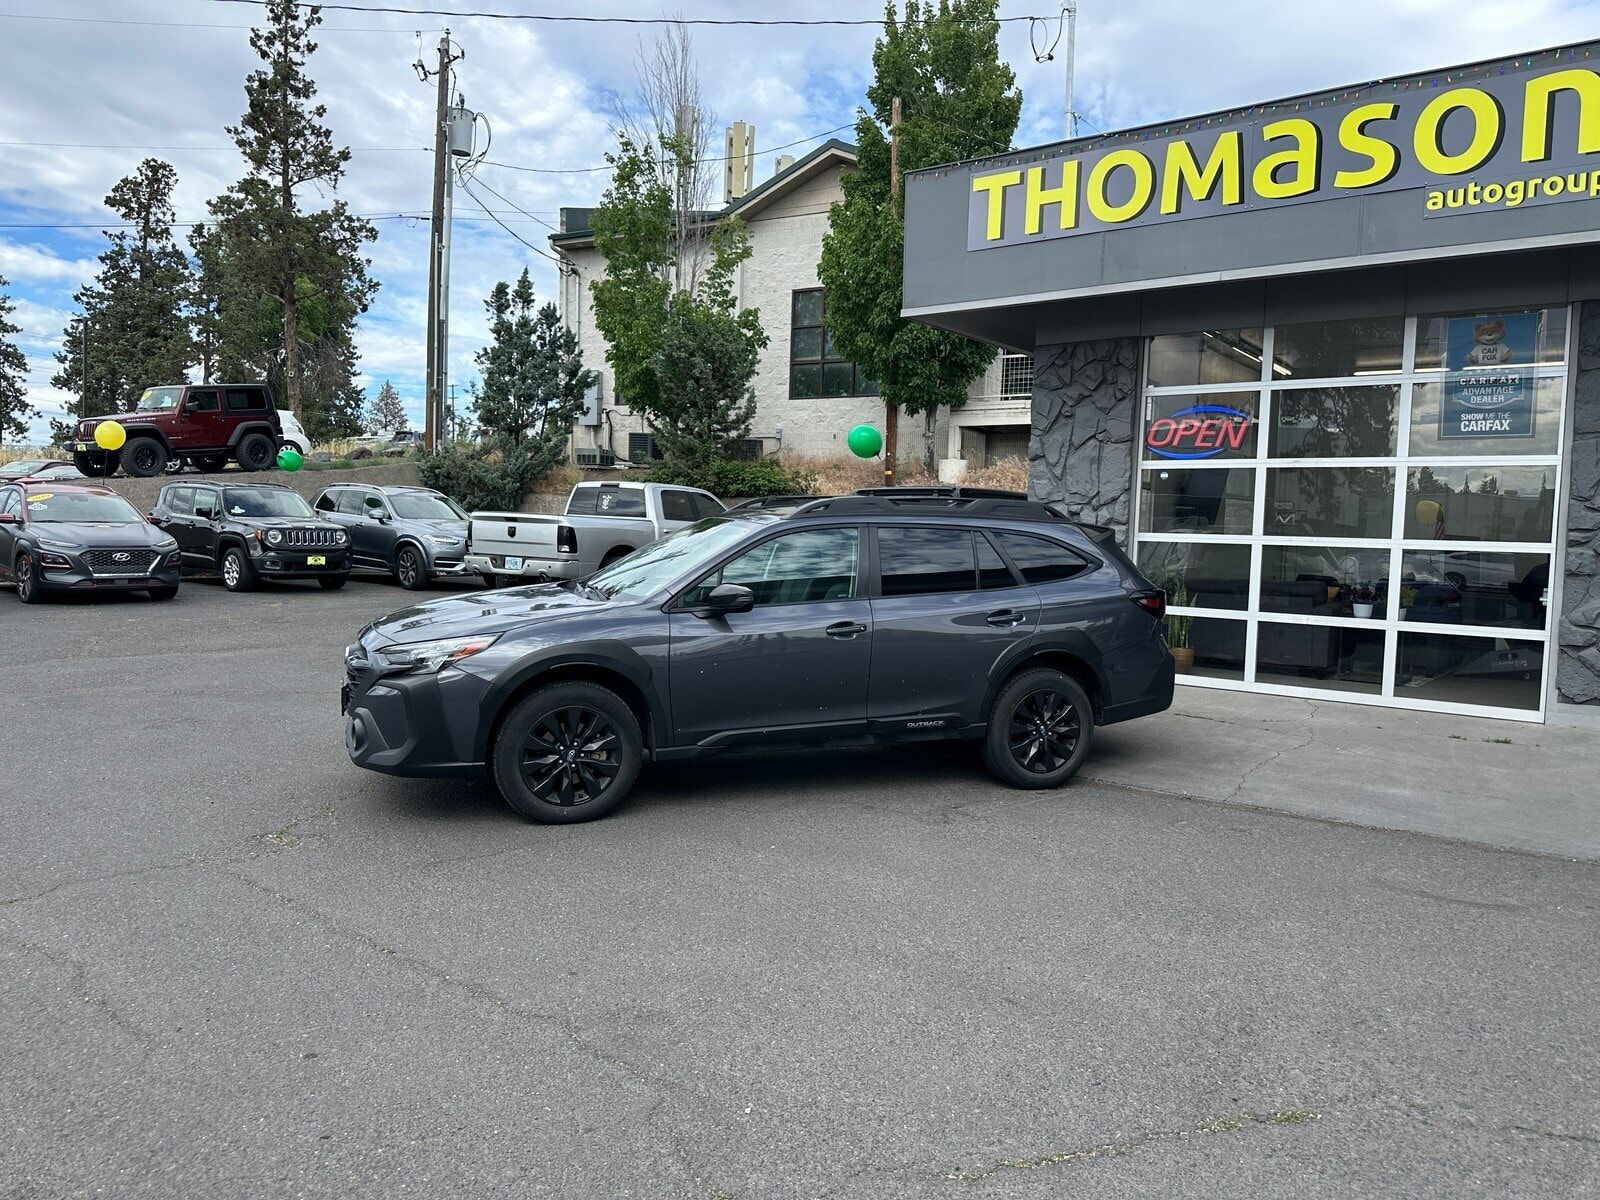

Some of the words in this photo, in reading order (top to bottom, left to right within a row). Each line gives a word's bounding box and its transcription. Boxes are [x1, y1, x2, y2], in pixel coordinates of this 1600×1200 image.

[1459, 376, 1518, 385] CARFAX
[1462, 386, 1514, 396] ADVANTAGE
[1470, 395, 1505, 404] DEALER
[1460, 413, 1484, 421] SHOW
[1485, 412, 1496, 420] ME
[1497, 411, 1511, 419] THE
[1460, 420, 1511, 432] CARFAX
[1146, 417, 1249, 449] OPEN
[906, 720, 944, 728] OUTBACK
